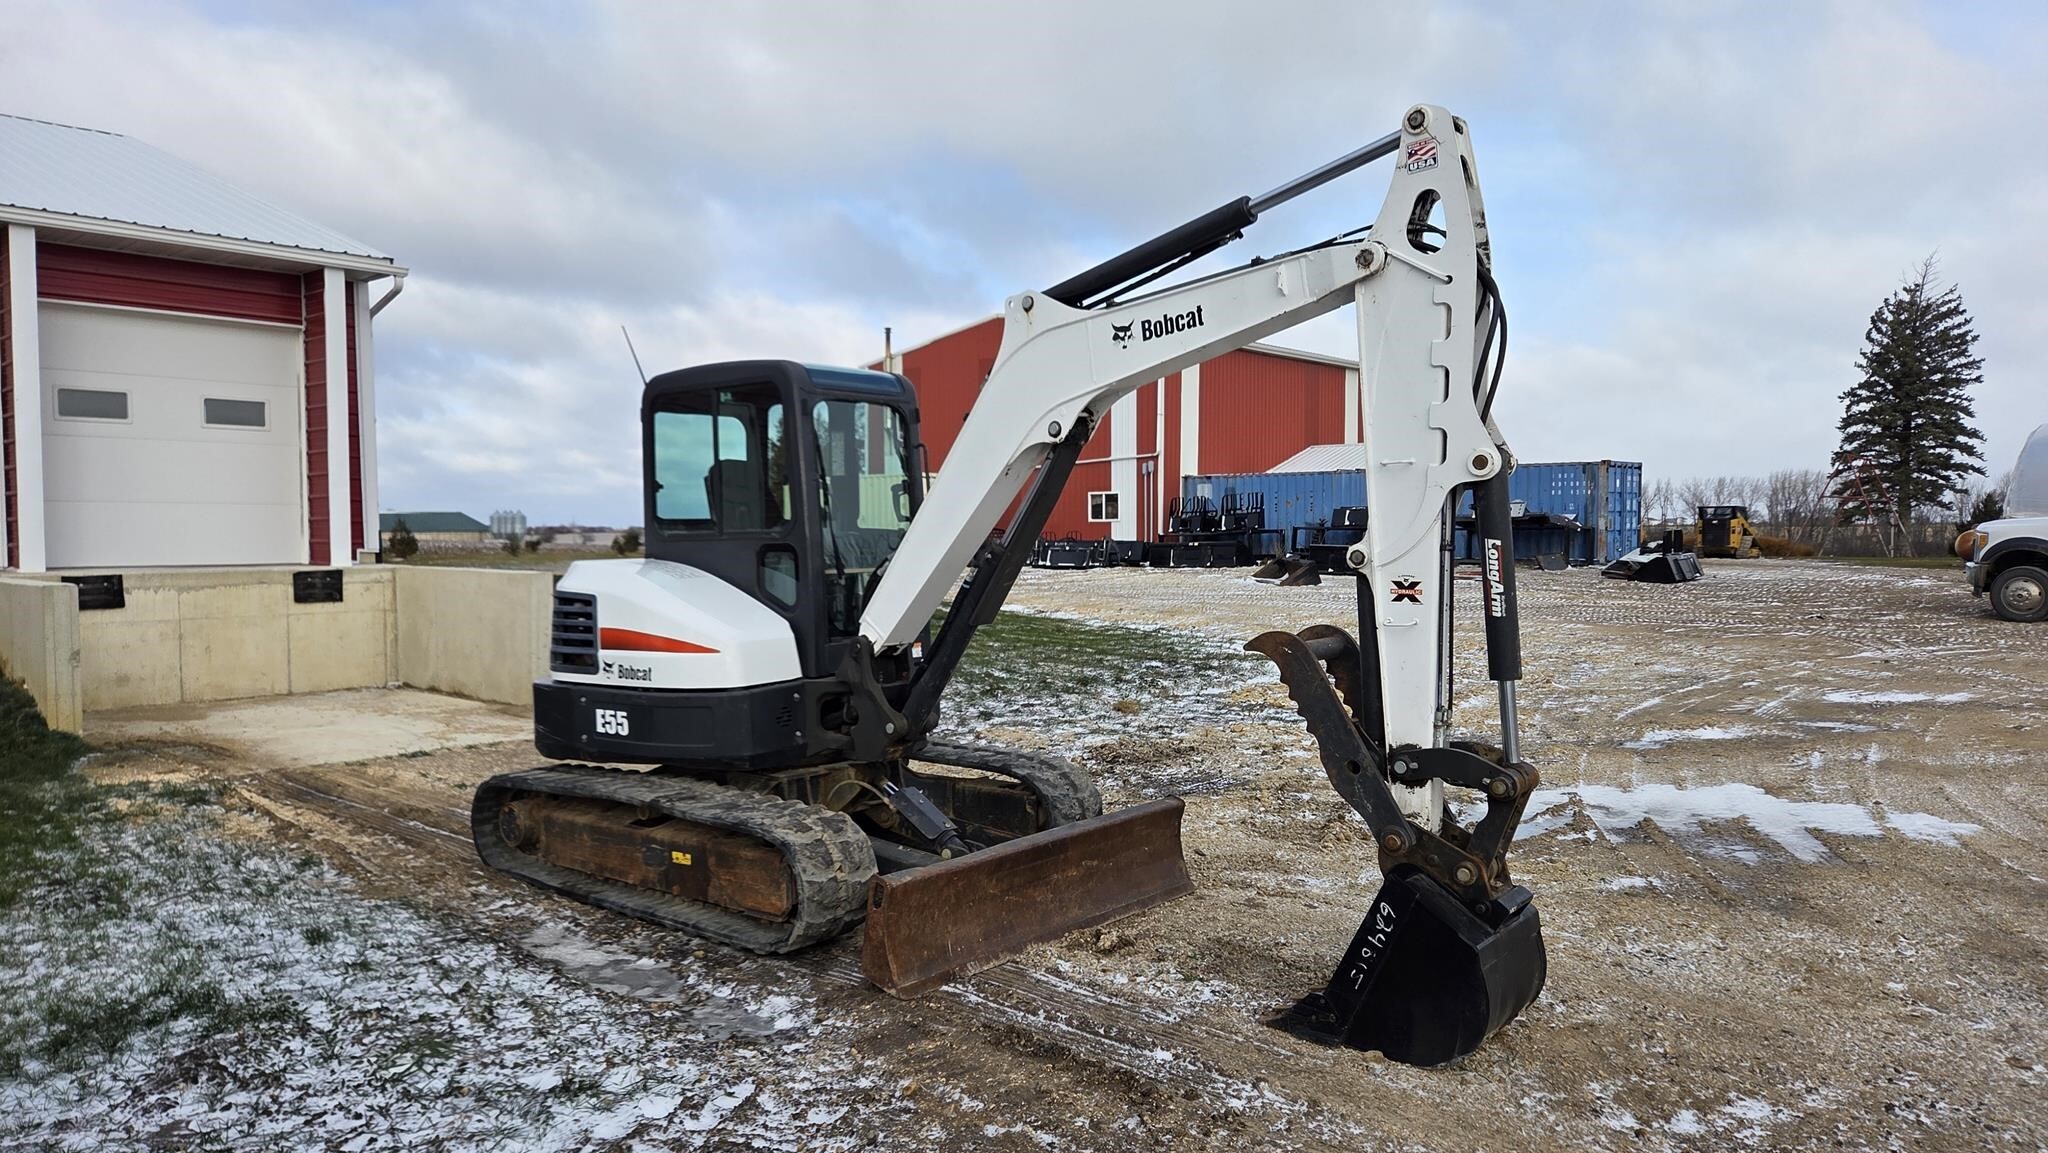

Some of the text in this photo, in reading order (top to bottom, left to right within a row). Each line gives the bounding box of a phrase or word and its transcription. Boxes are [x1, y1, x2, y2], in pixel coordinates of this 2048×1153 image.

[1409, 158, 1435, 170] USA
[1141, 305, 1205, 341] Bobcat
[1487, 538, 1505, 617] LongArm
[618, 664, 652, 682] Bobcat
[595, 708, 629, 736] E55
